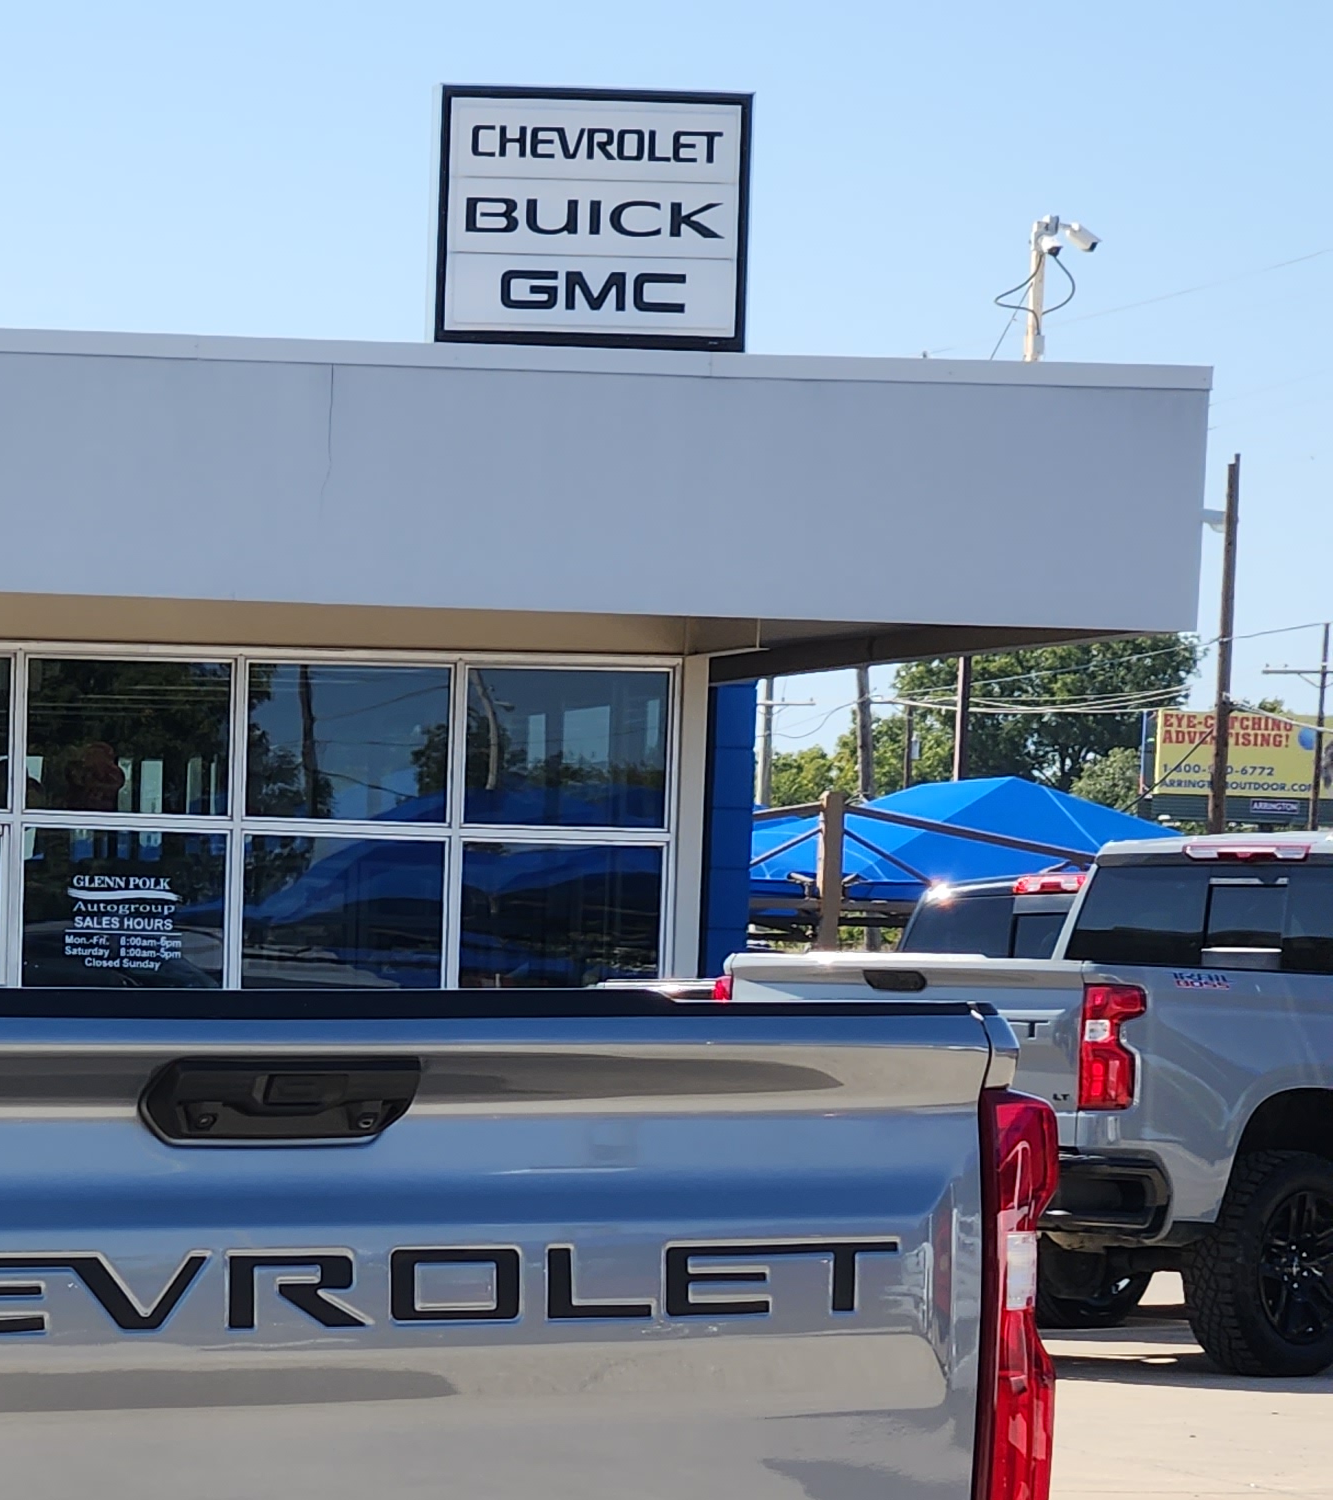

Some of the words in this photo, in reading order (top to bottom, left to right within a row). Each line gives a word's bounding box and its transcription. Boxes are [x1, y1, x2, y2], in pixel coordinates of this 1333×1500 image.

[471, 124, 724, 164] CHEVROLET
[465, 197, 725, 239] BUICK
[500, 269, 687, 314] GMC
[1163, 713, 1293, 732] EYE-CTCHING
[73, 875, 126, 888] GLENN
[129, 877, 172, 890] POLK
[73, 901, 175, 915] Autogroup
[74, 916, 120, 928] SALES
[124, 917, 174, 930] HOURS
[65, 946, 110, 958] Saturday
[85, 957, 120, 967] Closed
[122, 959, 161, 971] Sunday
